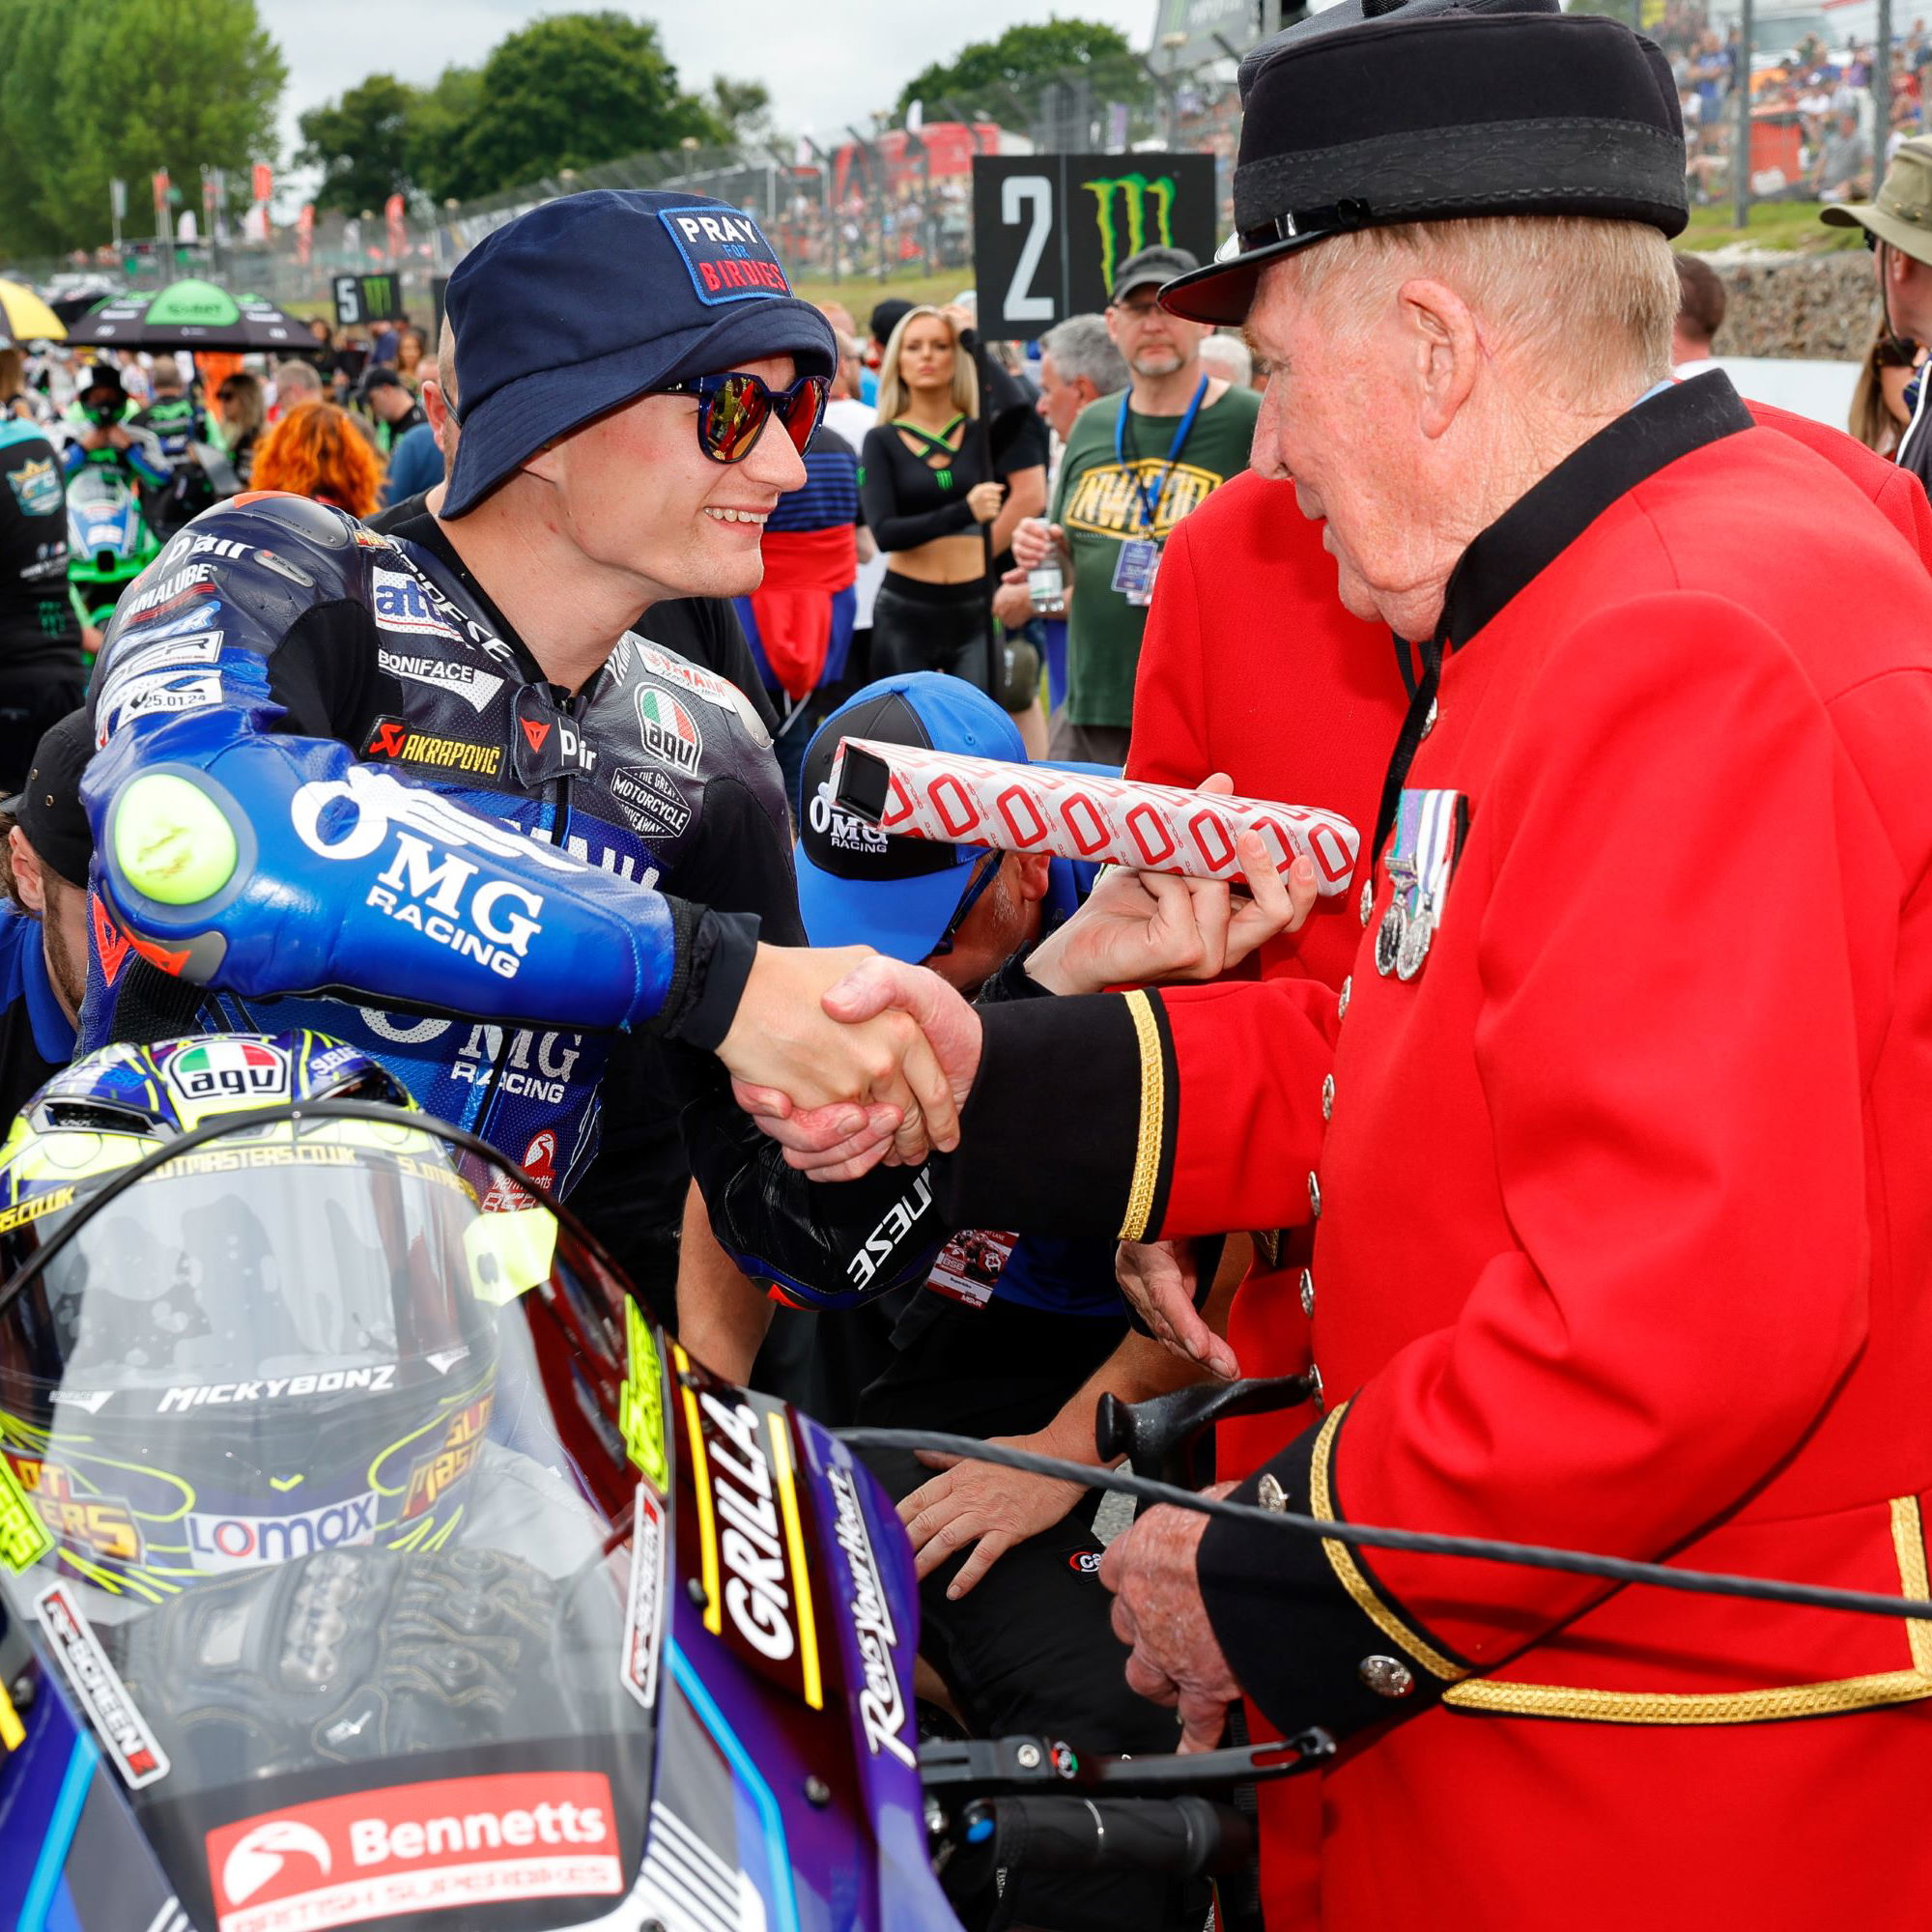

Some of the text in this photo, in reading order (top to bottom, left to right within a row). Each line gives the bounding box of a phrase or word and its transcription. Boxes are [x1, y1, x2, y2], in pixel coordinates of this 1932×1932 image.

[676, 216, 757, 243] PRAY
[1001, 177, 1054, 321] 2
[722, 244, 751, 259] FOR
[698, 260, 788, 292] BIRDIES
[336, 277, 359, 323] 5
[378, 649, 473, 683] BONIFACE
[648, 723, 695, 767] agv
[612, 774, 689, 831] MOTORCYCLE
[639, 771, 677, 799] THE GREAT
[831, 837, 888, 853] RACING
[291, 780, 544, 956] OMG
[366, 884, 522, 979] RACING
[190, 1068, 274, 1094] agv
[450, 1061, 566, 1104] RACING
[846, 1167, 933, 1292] NESE
[943, 1257, 965, 1271] BSB
[156, 1364, 396, 1413] MICKYBONZ
[699, 1391, 794, 1661] GRILLA
[1079, 1552, 1102, 1570] ca
[349, 1802, 608, 1866] Bennetts
